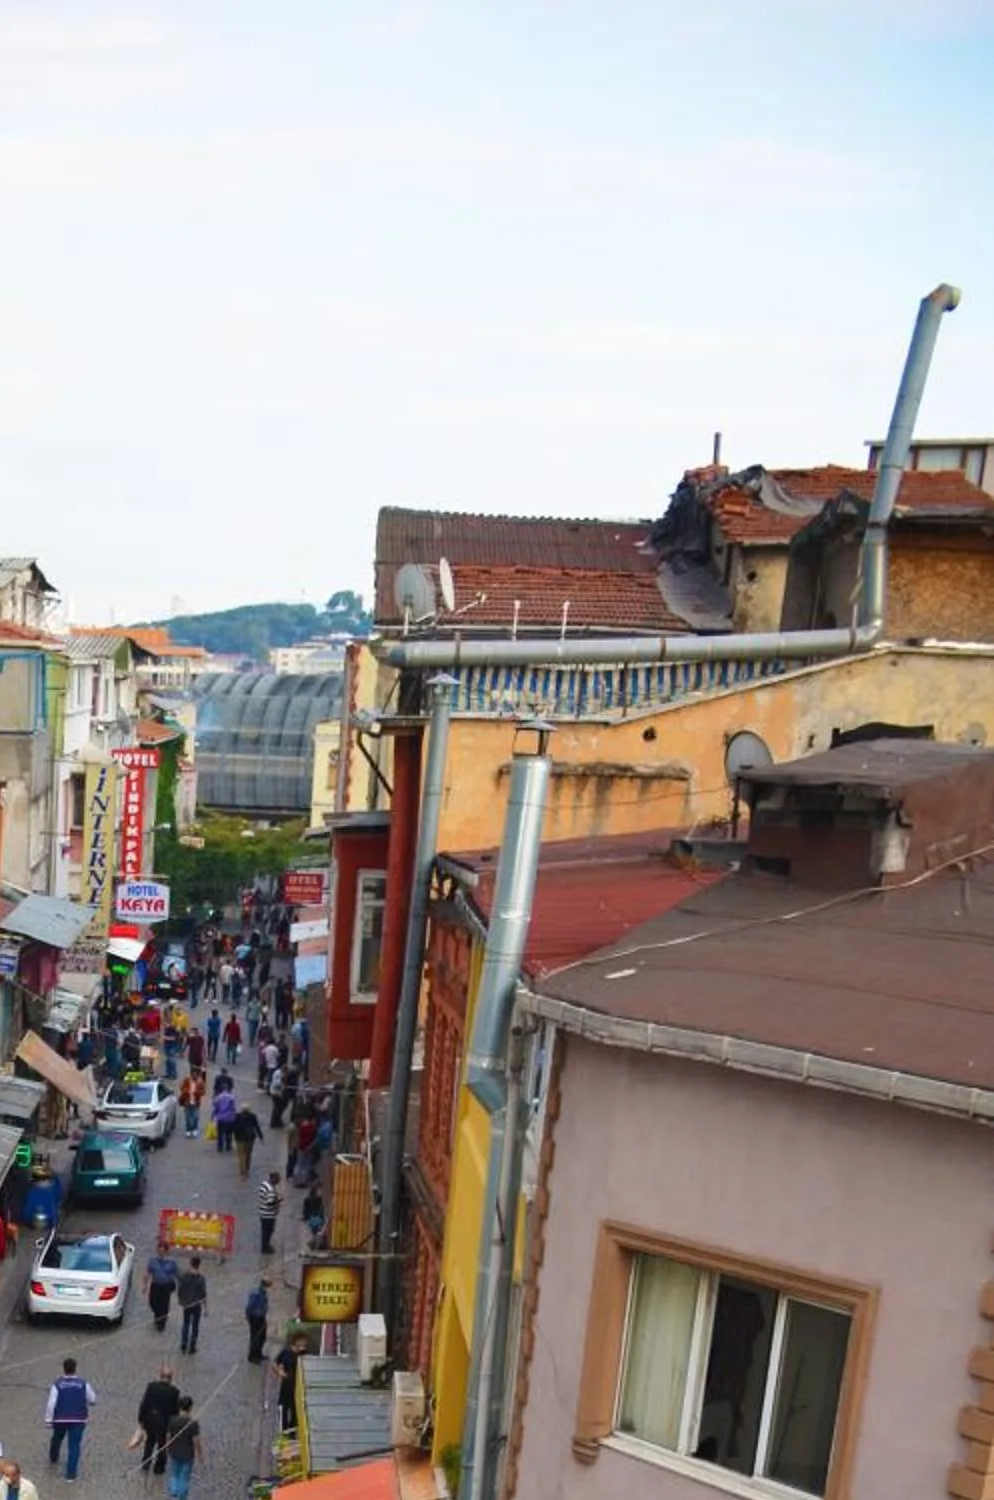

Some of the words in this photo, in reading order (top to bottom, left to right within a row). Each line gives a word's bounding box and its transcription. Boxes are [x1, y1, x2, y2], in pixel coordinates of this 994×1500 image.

[89, 767, 111, 909] İNTERNE
[127, 885, 159, 897] HOTEL
[121, 899, 166, 913] KAYA
